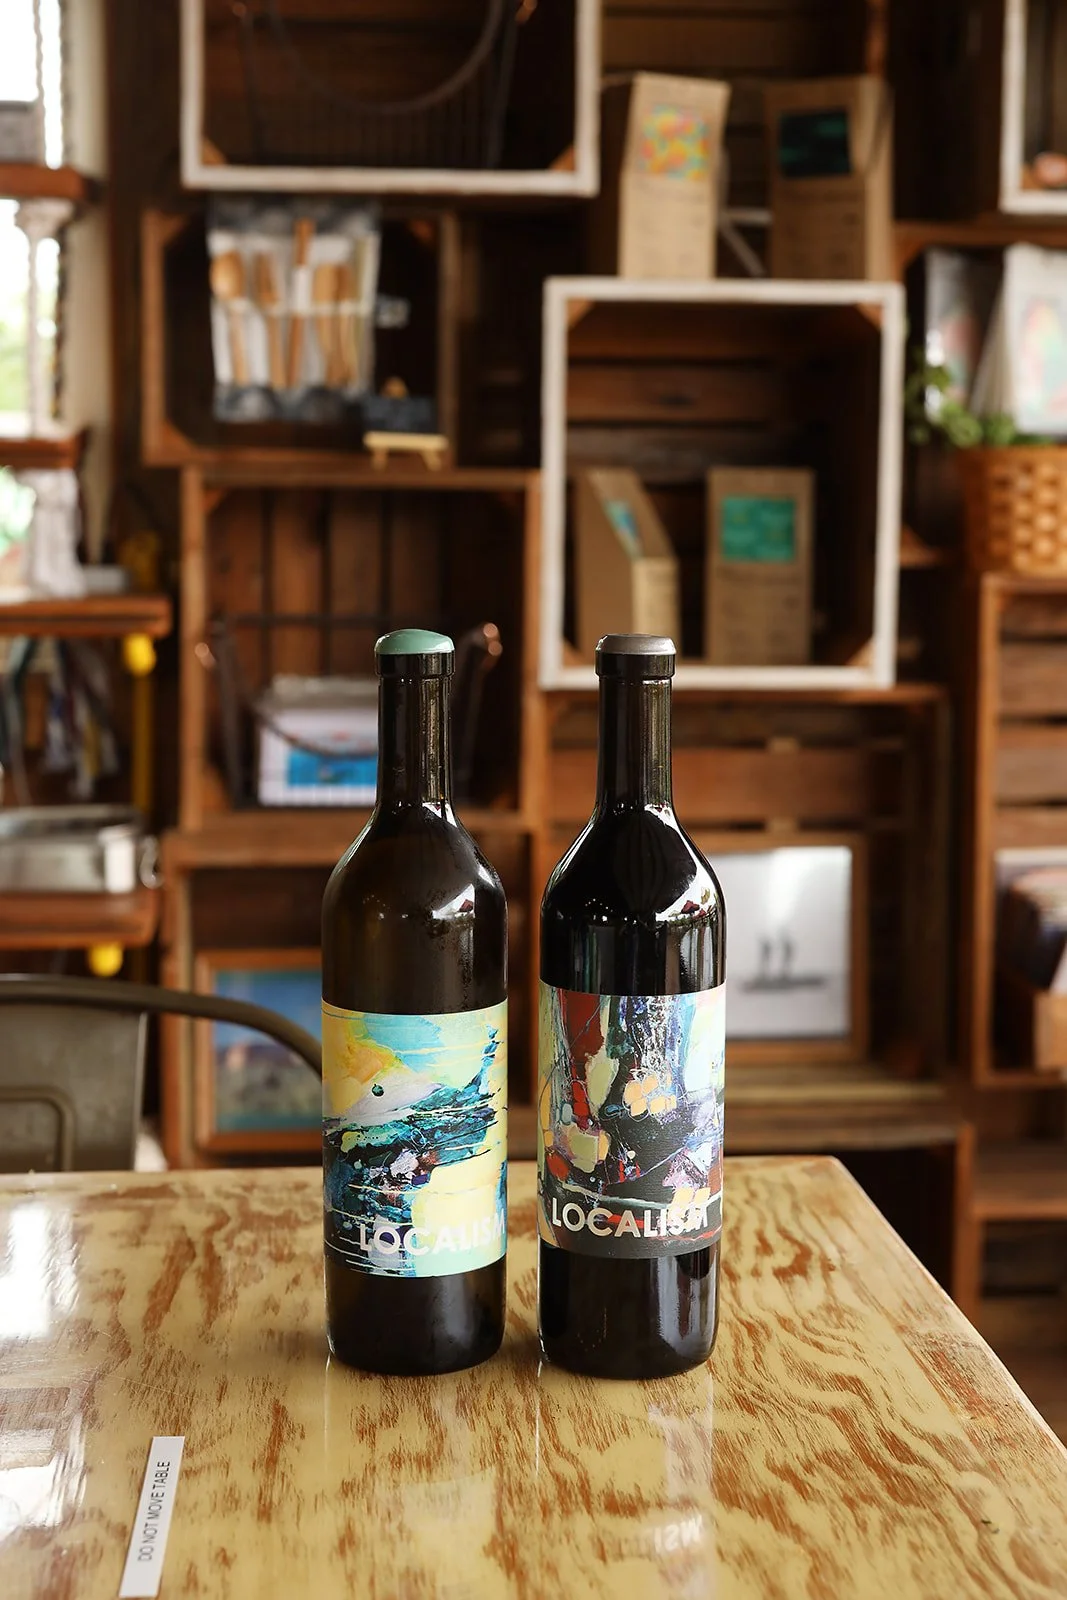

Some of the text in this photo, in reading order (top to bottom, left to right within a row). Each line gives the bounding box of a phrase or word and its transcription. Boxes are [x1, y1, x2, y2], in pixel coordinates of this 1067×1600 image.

[359, 1208, 505, 1256] LOCALISM
[552, 1197, 709, 1238] LOCALISM
[137, 1461, 171, 1562] DO NOT MOVE TABLE
